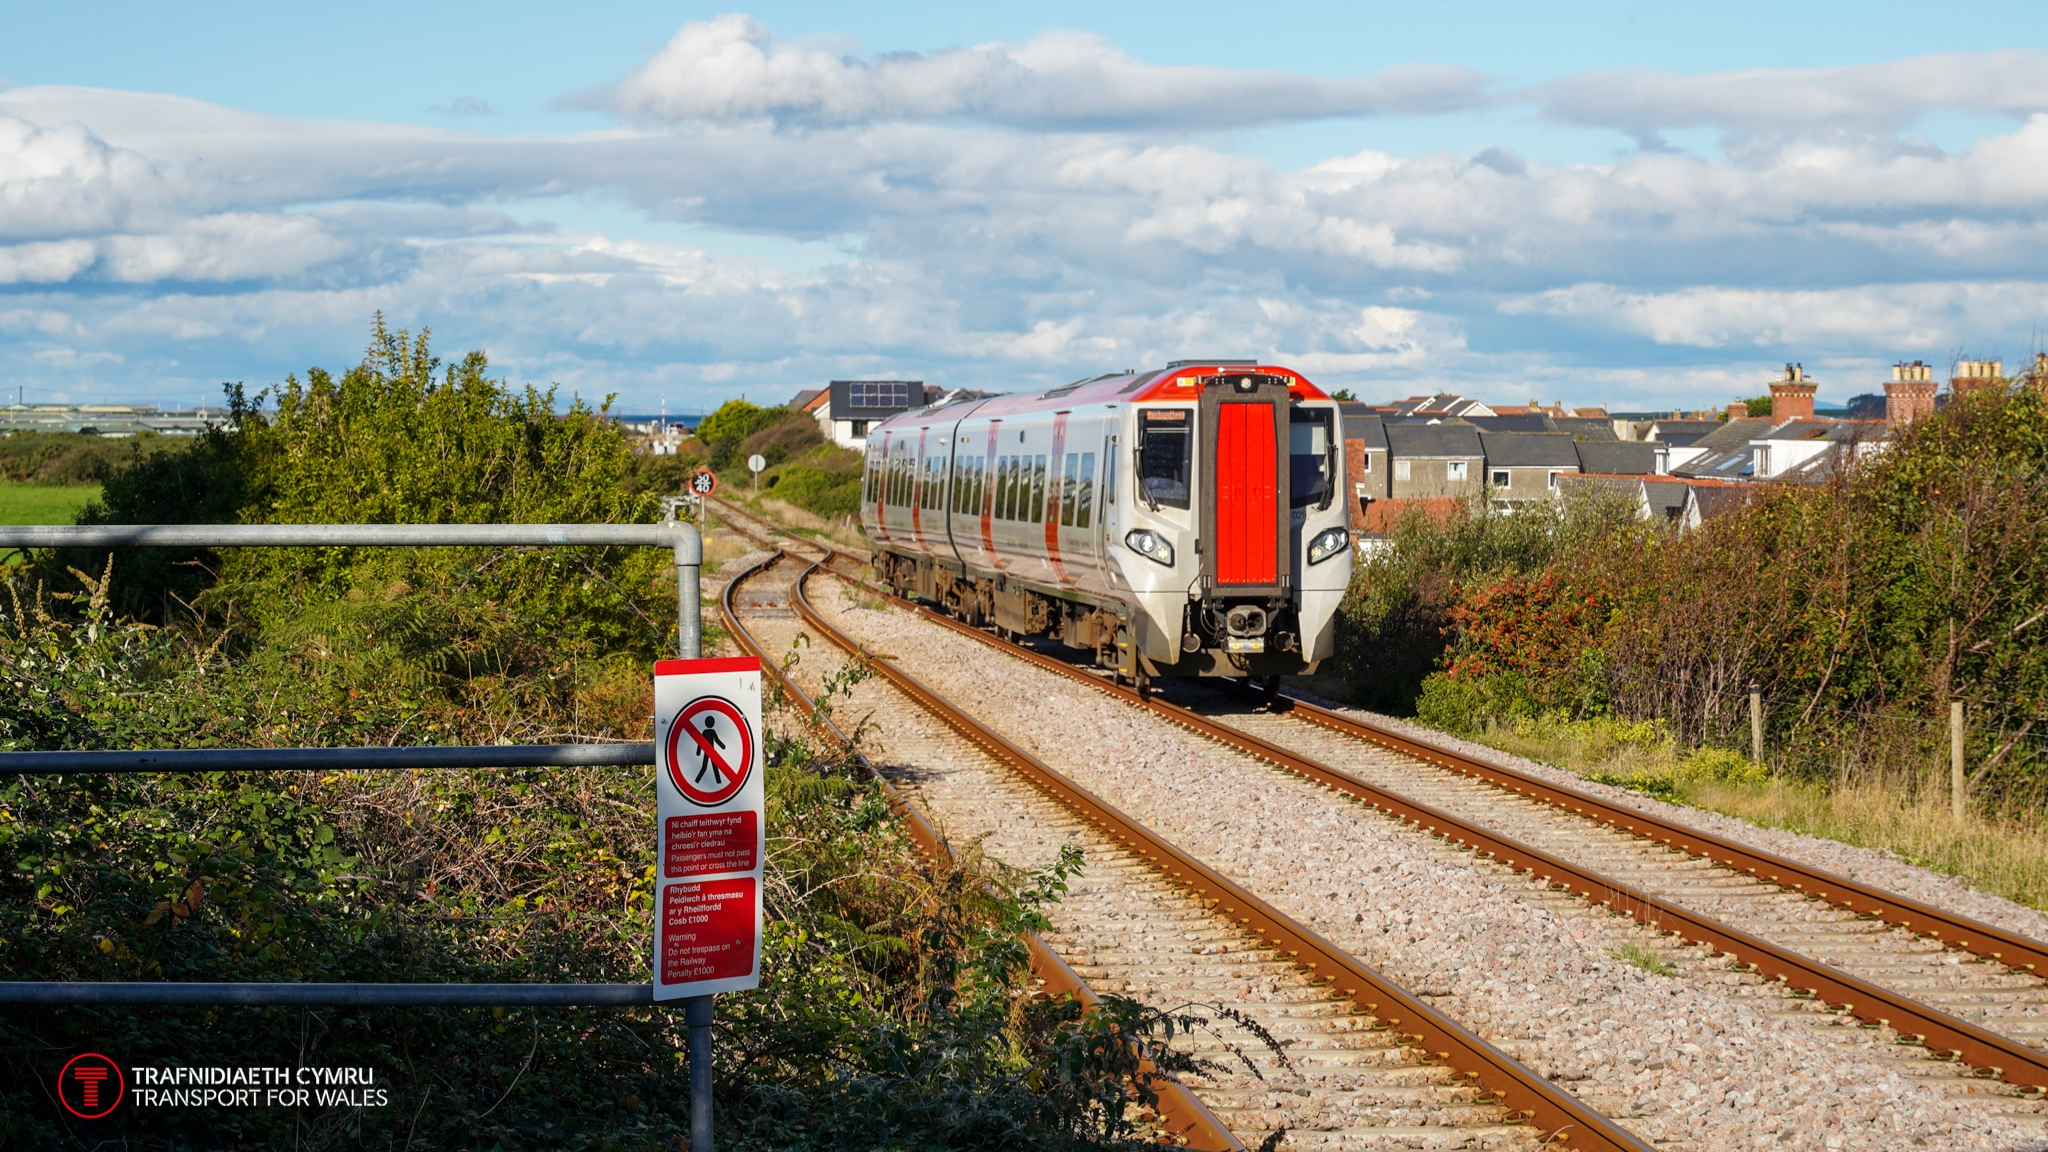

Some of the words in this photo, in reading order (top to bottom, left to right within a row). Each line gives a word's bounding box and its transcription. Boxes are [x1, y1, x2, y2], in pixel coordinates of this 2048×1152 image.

[696, 483, 710, 493] 40
[680, 819, 698, 828] chaiff
[699, 818, 725, 827] teithwyr
[726, 816, 742, 826] fynd
[672, 830, 696, 839] heibio'r
[709, 830, 722, 838] yma
[700, 840, 725, 848] cledrau
[672, 852, 706, 862] Passengers
[736, 850, 750, 858] pass
[683, 864, 700, 874] point
[670, 884, 700, 895] Rhybudd
[670, 895, 700, 904] Peidiwch
[708, 892, 744, 901] thresmasu
[678, 908, 682, 916] y
[684, 903, 722, 914] Rheilffordd
[668, 916, 686, 926] Cosb
[688, 914, 708, 924] £1000
[668, 932, 696, 942] Warning
[668, 948, 678, 956] Do
[692, 944, 720, 954] trespass
[668, 959, 678, 968] the
[680, 957, 706, 966] Railway
[668, 968, 692, 978] Penalty
[694, 966, 714, 976] £1000
